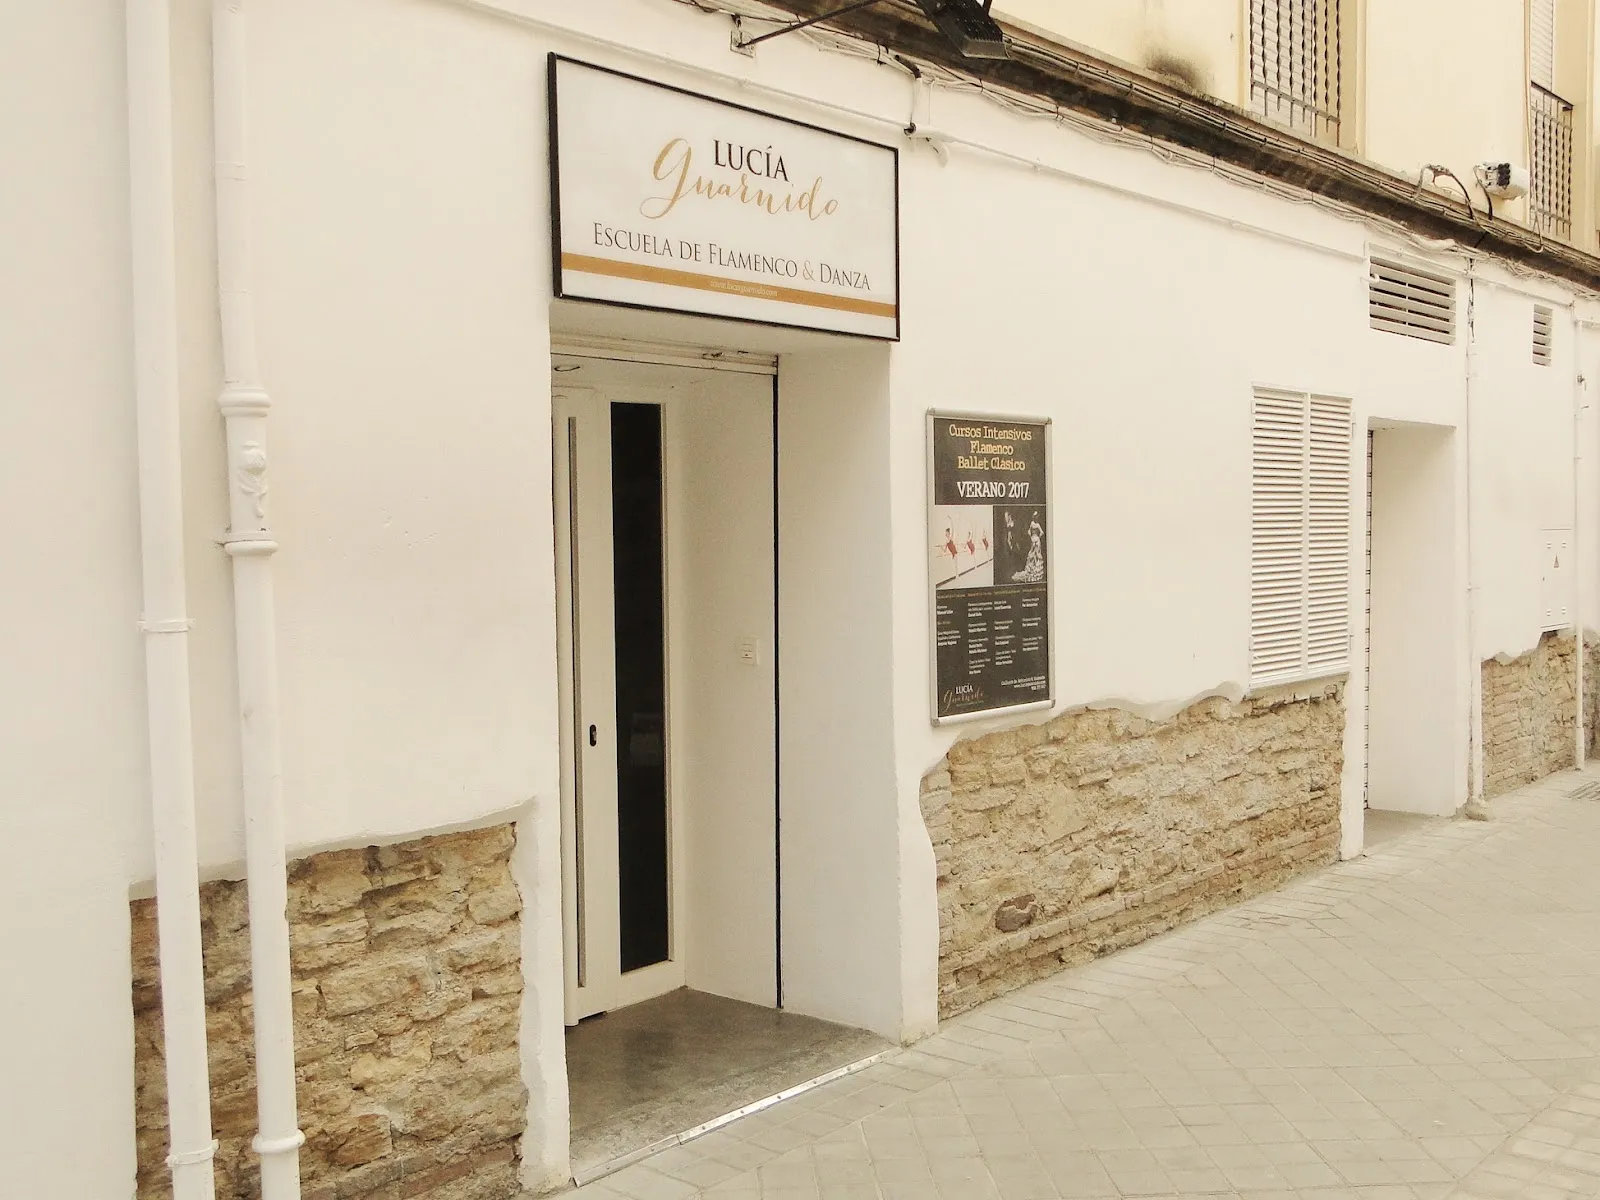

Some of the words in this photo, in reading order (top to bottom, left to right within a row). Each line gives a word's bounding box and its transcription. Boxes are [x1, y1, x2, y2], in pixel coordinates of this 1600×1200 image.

[713, 139, 790, 182] LUCÍA
[680, 240, 701, 262] DE
[802, 260, 816, 281] &
[949, 424, 981, 438] Cursos
[983, 426, 1032, 440] Intensivos
[970, 440, 1014, 455] Flamenco
[957, 456, 989, 470] Ballet
[956, 481, 1006, 498] VERANO
[1008, 482, 1030, 498] 2017
